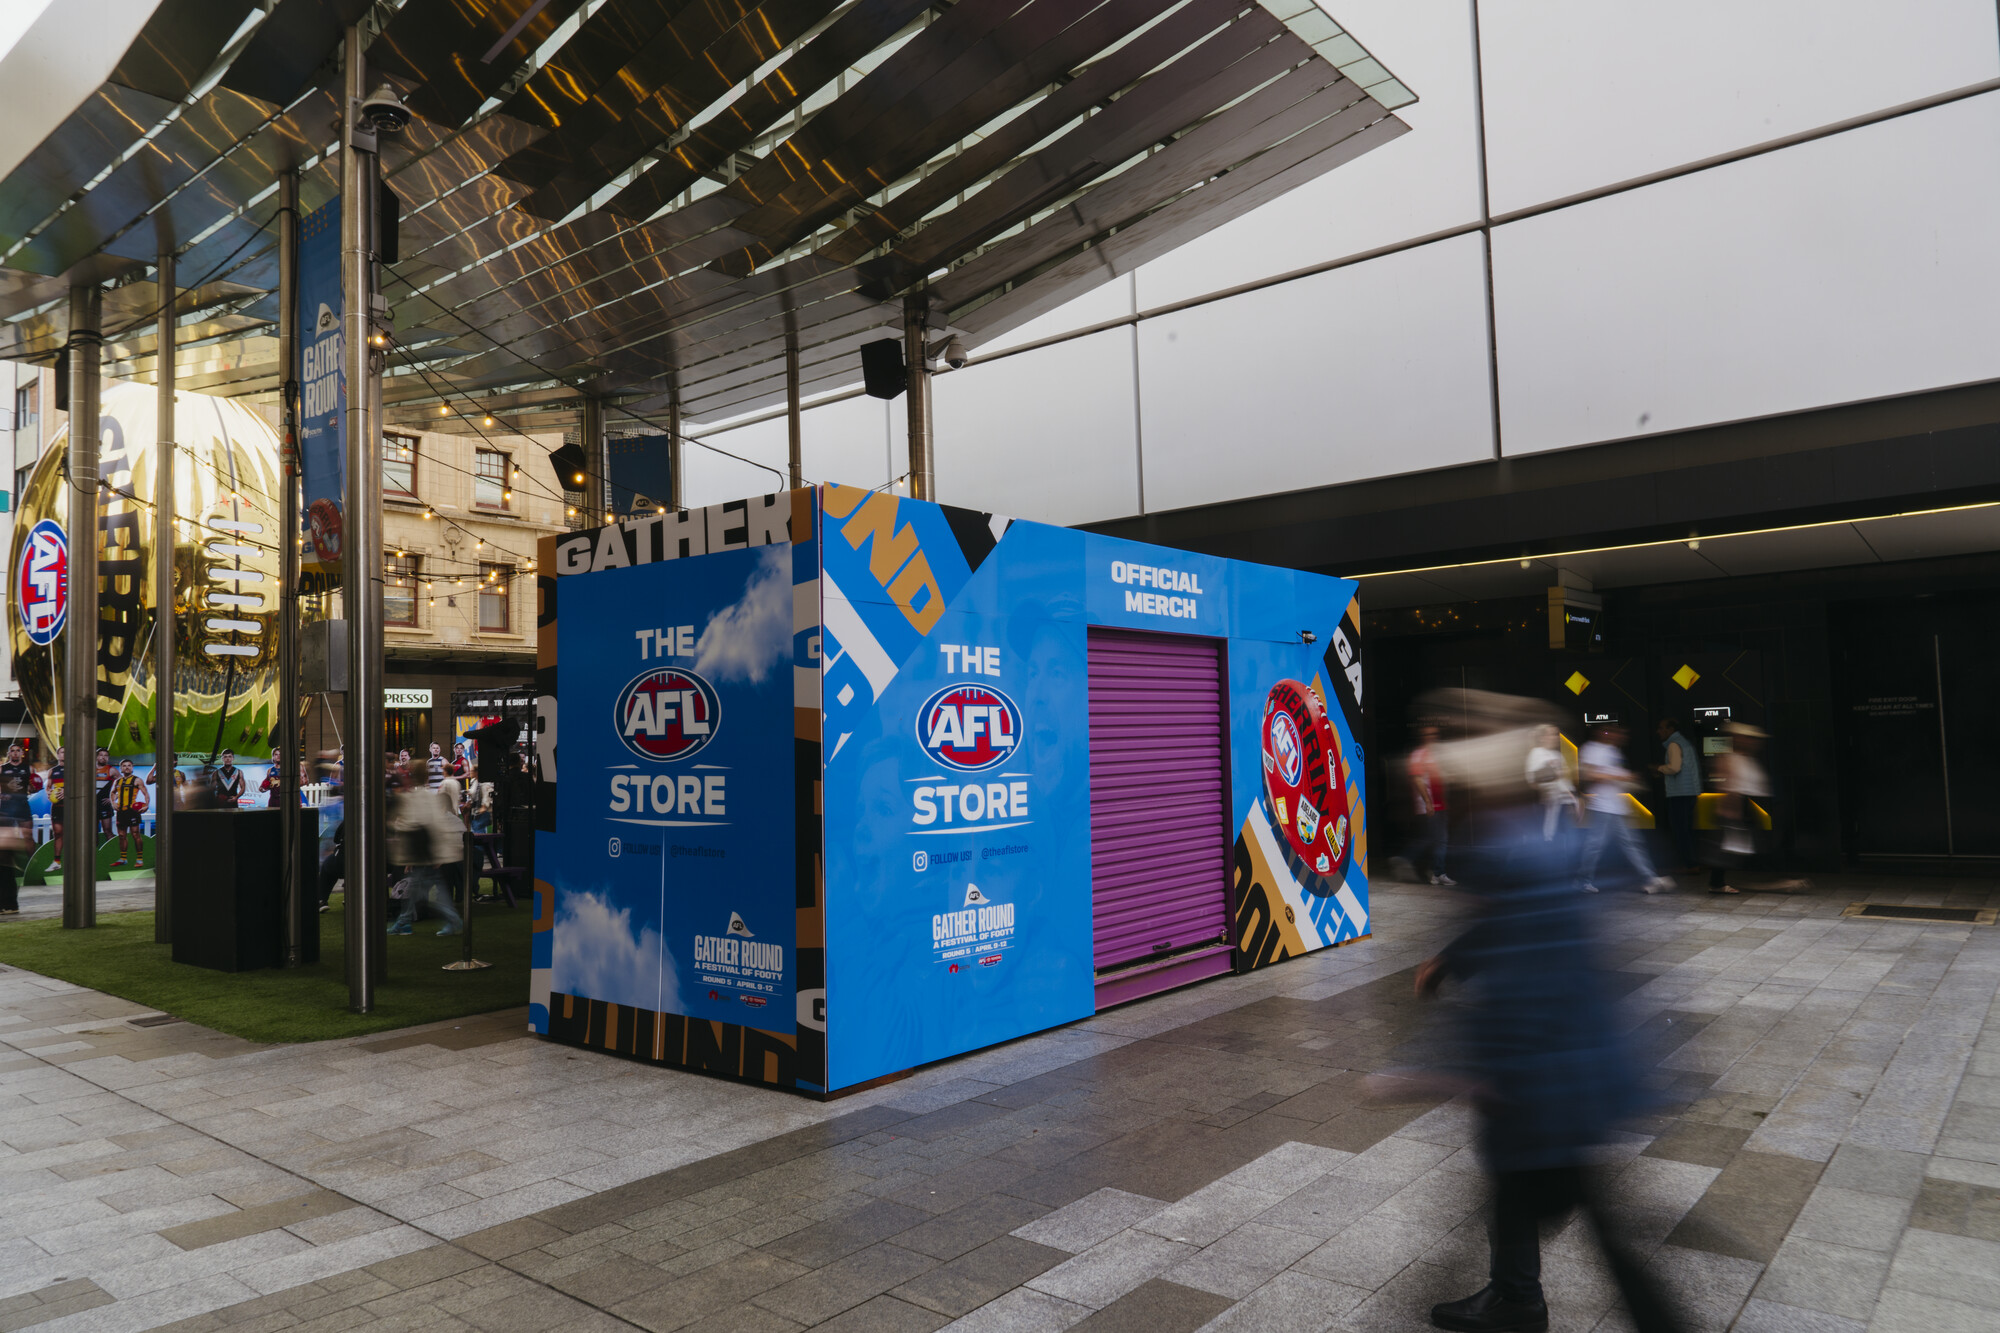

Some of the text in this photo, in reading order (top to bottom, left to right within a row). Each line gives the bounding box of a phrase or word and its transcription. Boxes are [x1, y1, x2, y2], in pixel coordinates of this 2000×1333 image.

[556, 490, 792, 576] GATHER
[29, 532, 59, 634] AFL
[1111, 560, 1203, 595] OFFICIAL
[1125, 590, 1197, 619] MERCH
[635, 624, 694, 660] THE
[940, 643, 1000, 677] THE
[623, 689, 710, 736] AFL
[927, 705, 1015, 748] AFL
[1269, 684, 1330, 817] SHERRIN
[1272, 718, 1298, 783] AFL
[609, 774, 726, 816] STORE
[912, 781, 1028, 826] STORE
[623, 843, 648, 855] FOLLOW
[930, 844, 1029, 865] FOLLOW US! @theaflstore
[932, 902, 1015, 941] GATHER ROUND
[933, 927, 1015, 950] A FESTIVAL OF FOOTY
[694, 934, 783, 972] GATHER ROUND
[942, 949, 965, 959] ROUND
[975, 944, 993, 953] APRIL
[993, 941, 1007, 949] 9-12
[694, 961, 783, 981] A FESTIVAL OF FOOTY
[702, 975, 726, 985] ROUND
[736, 980, 757, 989] APRIL
[757, 983, 774, 992] 9-12
